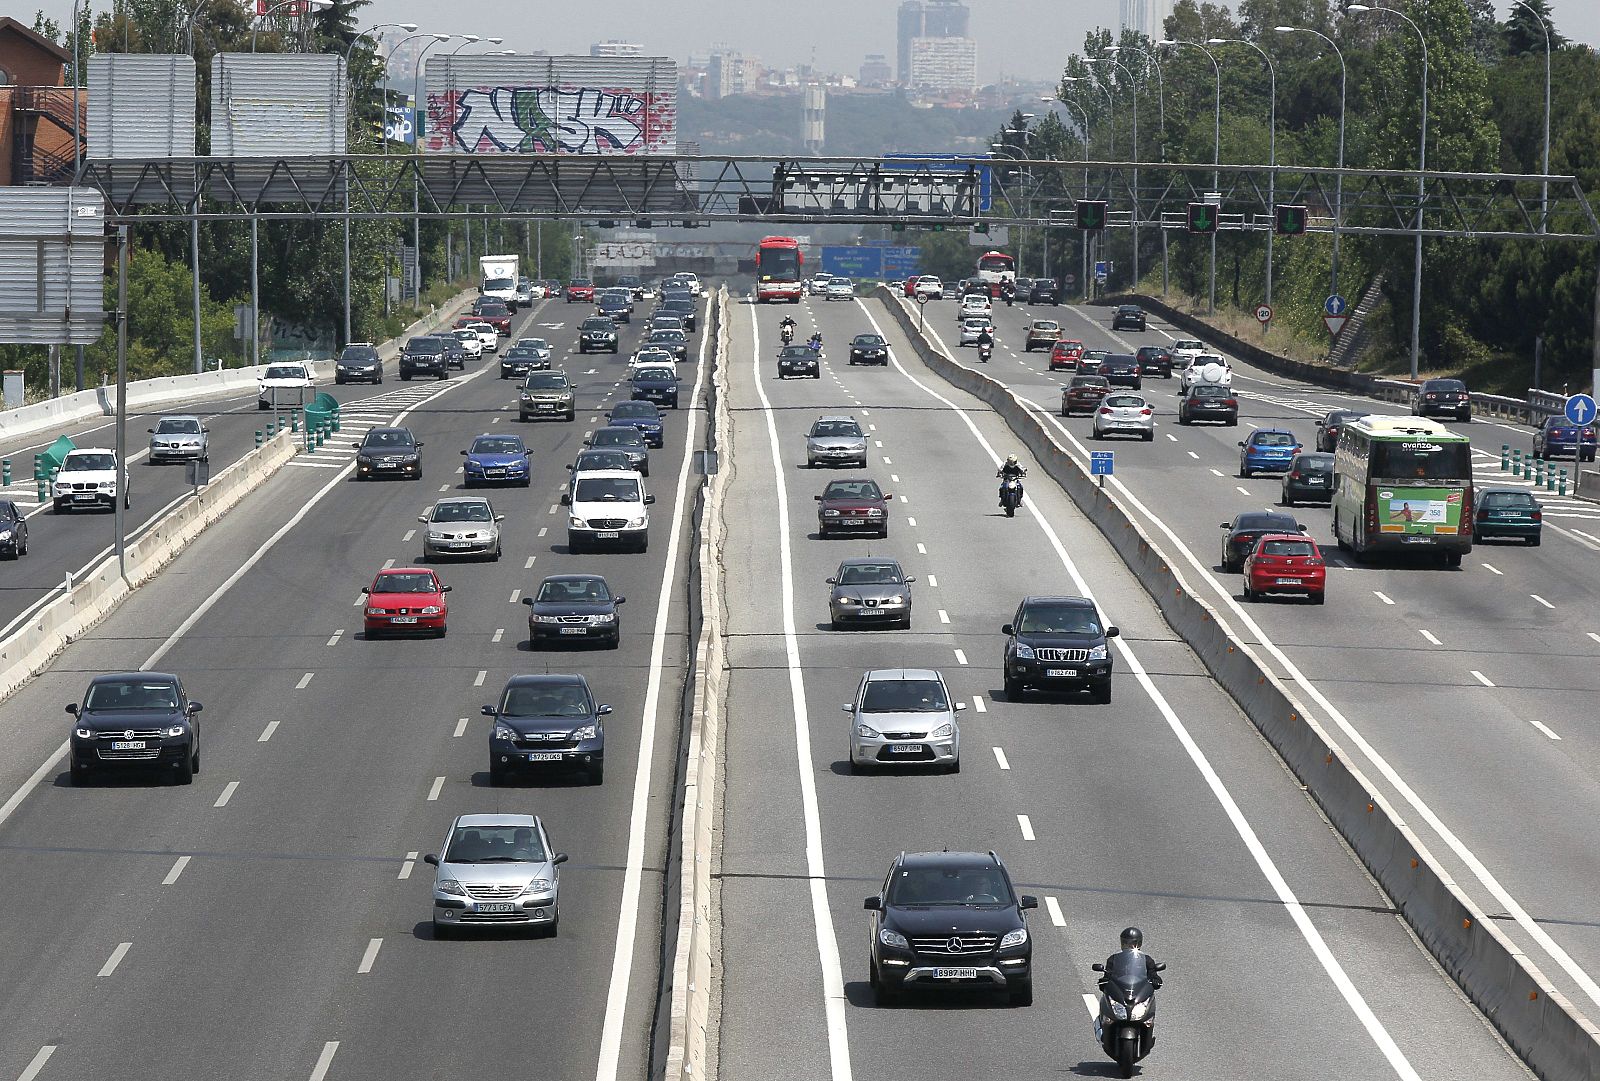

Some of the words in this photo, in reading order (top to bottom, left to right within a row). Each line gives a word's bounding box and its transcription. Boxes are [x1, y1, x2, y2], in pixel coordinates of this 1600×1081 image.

[479, 903, 497, 911] 5773
[938, 968, 958, 977] 8987
[959, 968, 975, 977] HHH
